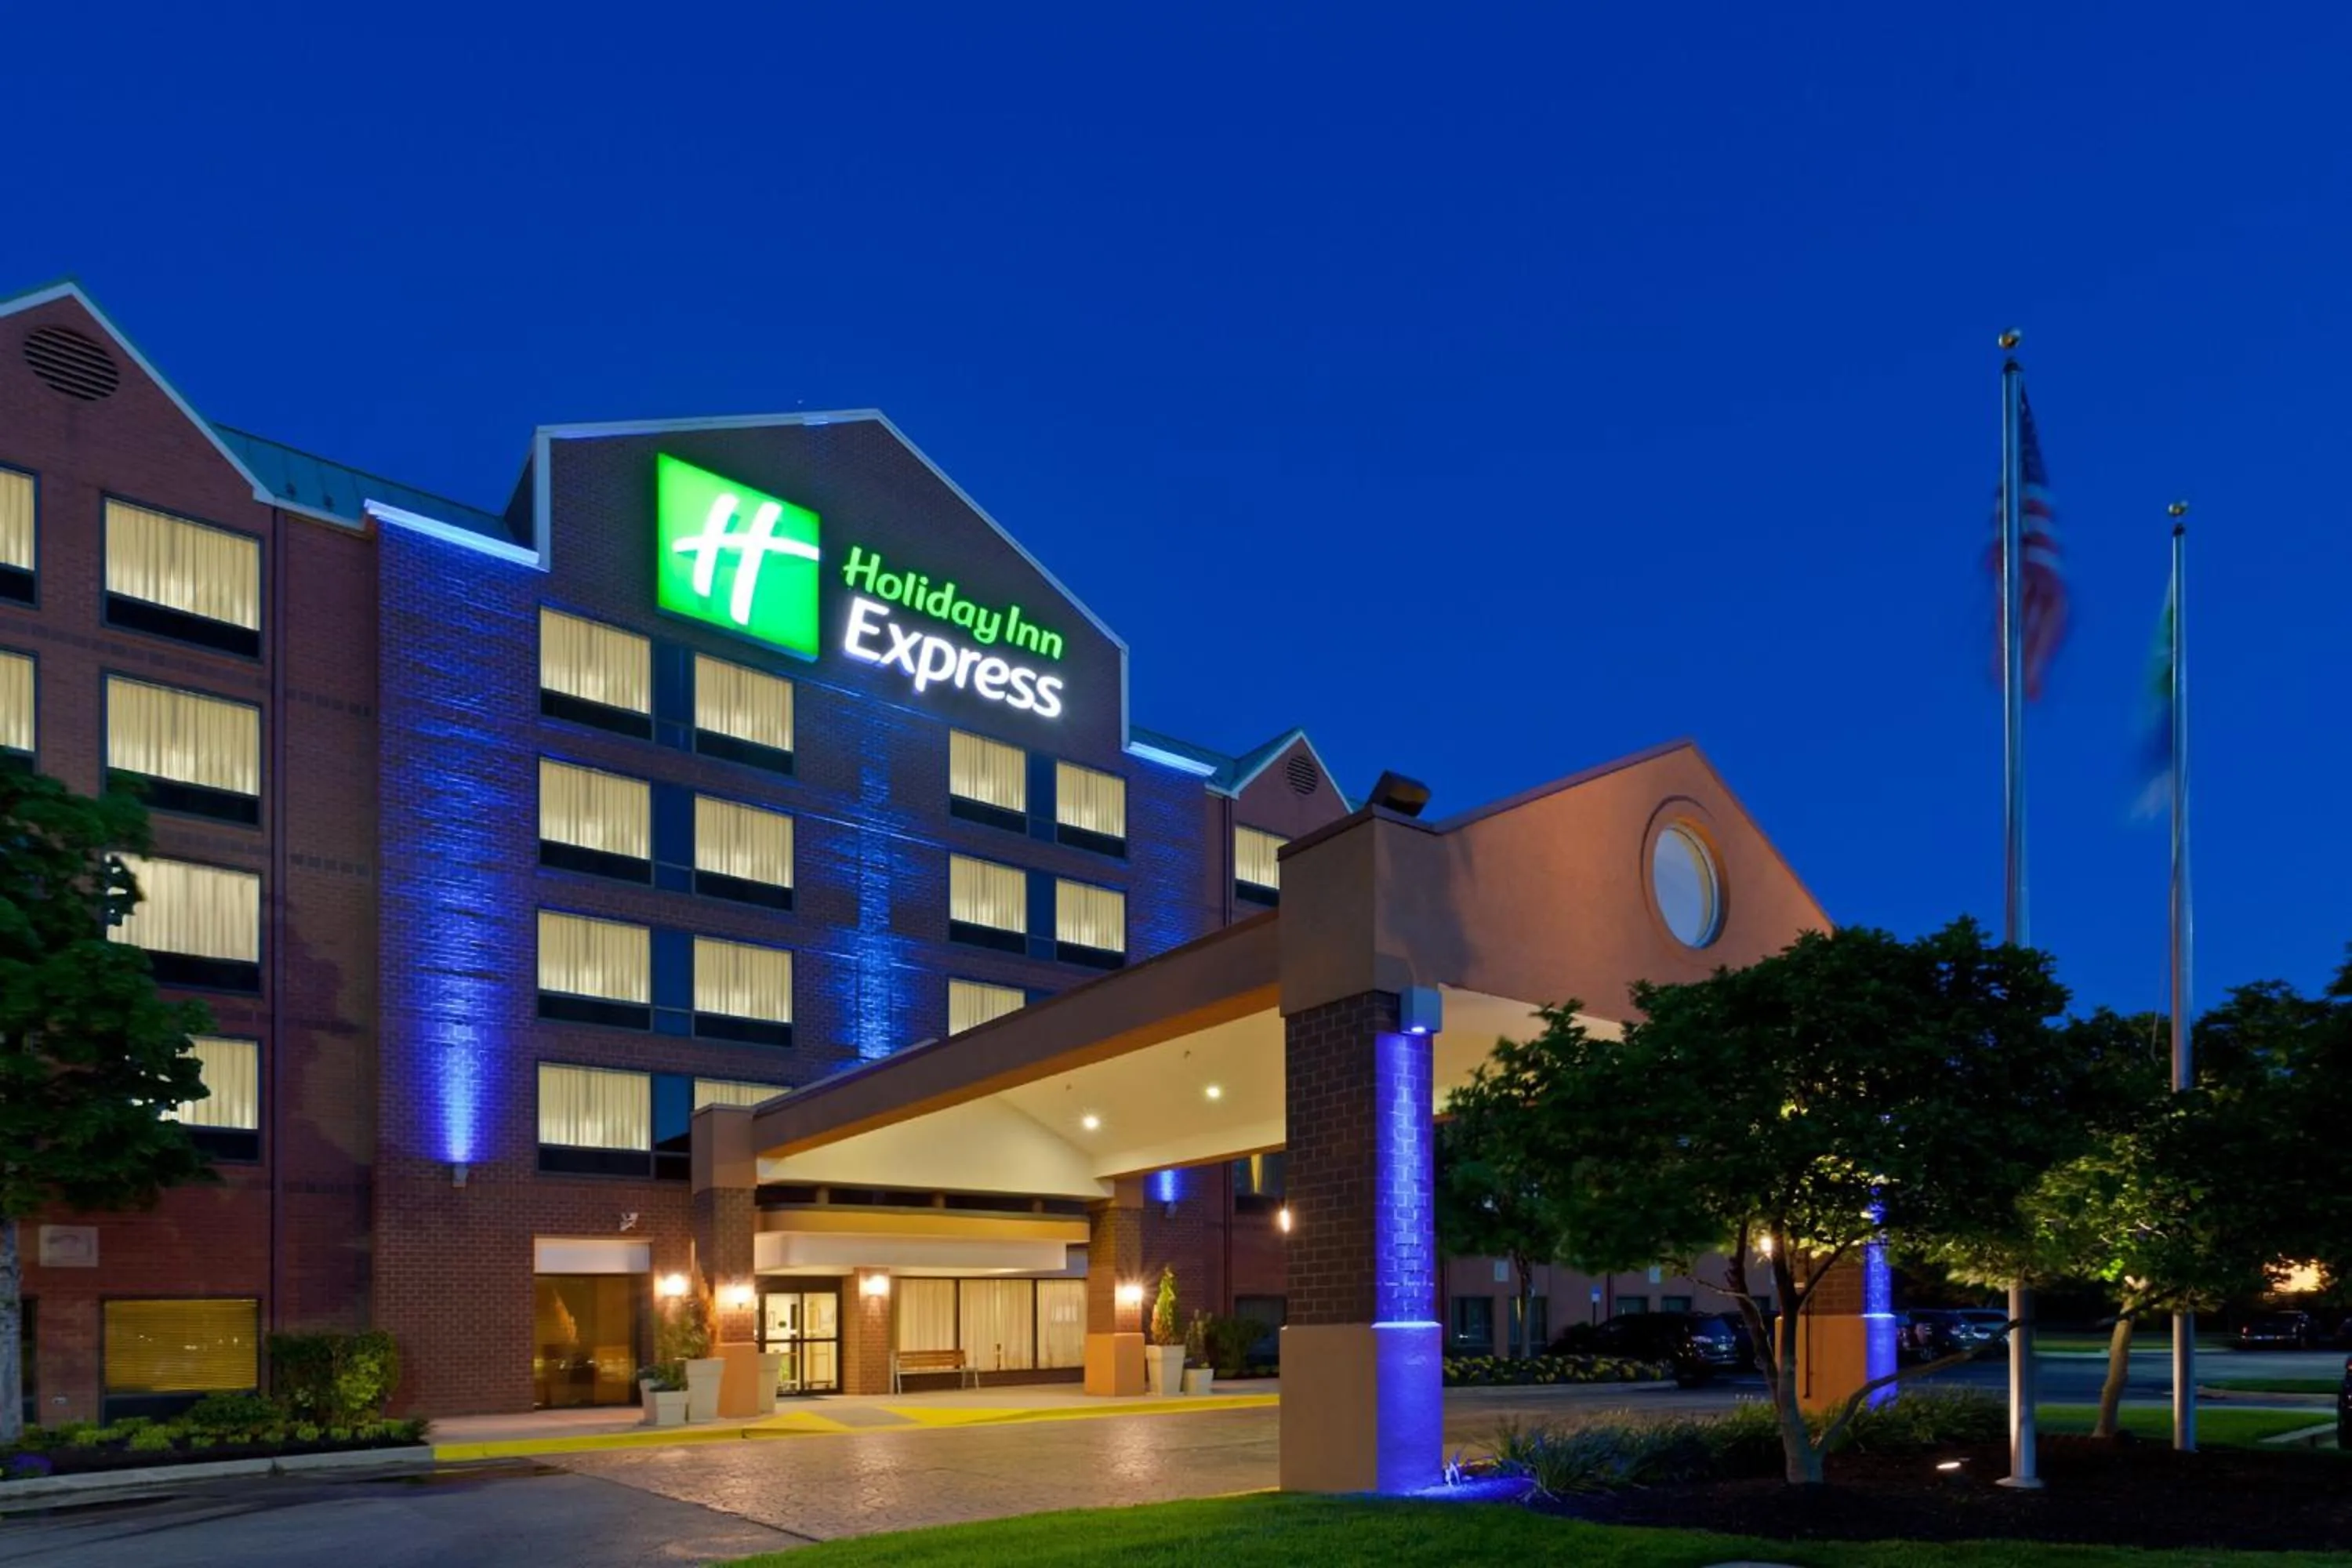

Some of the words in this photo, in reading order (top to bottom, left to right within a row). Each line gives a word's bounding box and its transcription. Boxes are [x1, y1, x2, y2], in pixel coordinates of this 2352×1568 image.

[843, 546, 1001, 644] Holiday
[1006, 606, 1064, 659] Inn
[844, 596, 1064, 718] Express
